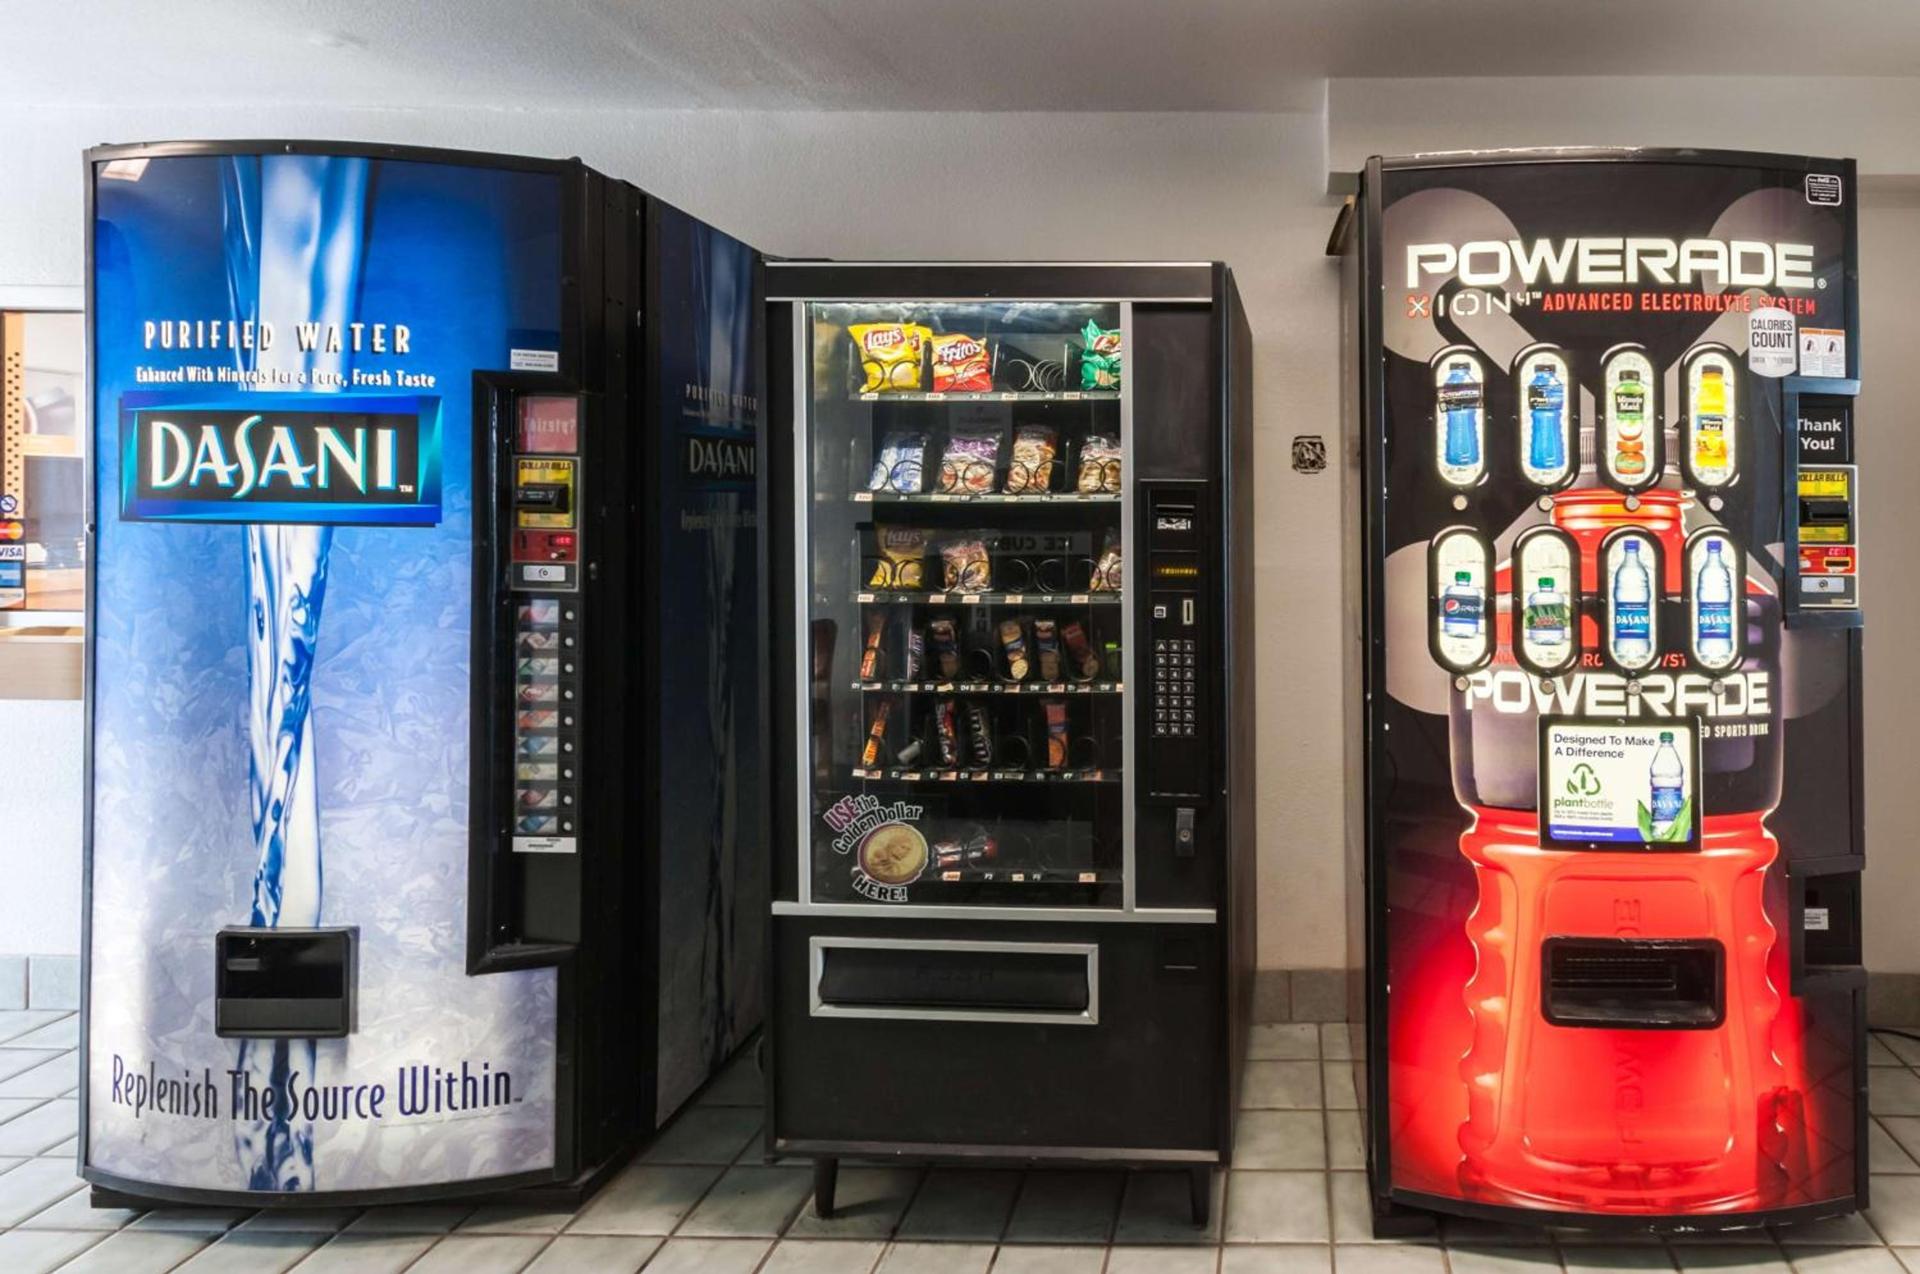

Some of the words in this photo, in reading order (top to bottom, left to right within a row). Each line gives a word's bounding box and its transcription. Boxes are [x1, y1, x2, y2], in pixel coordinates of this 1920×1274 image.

[1542, 292, 1633, 312] ADVANCED
[1641, 292, 1751, 313] ELECTROLYTE
[1759, 296, 1816, 315] SYSTEM
[1751, 318, 1793, 331] CALORIES
[144, 320, 275, 351] PURIFIED
[296, 321, 411, 355] WATER
[1751, 332, 1793, 349] COUNT
[136, 366, 184, 383] Enhanced
[187, 366, 214, 383] With
[217, 366, 267, 384] Minerals
[297, 373, 306, 384] a
[352, 367, 391, 386] Fresh
[396, 369, 436, 388] Taste
[1797, 418, 1842, 432] Thank
[1800, 437, 1835, 450] You!
[690, 438, 754, 477] DASANI
[1714, 725, 1748, 737] SPORTS
[1749, 723, 1769, 736] DRINK
[1554, 733, 1607, 747] Designed
[1609, 735, 1622, 746] To
[1625, 736, 1655, 747] Make
[1554, 747, 1563, 756] A
[1566, 747, 1625, 759] Difference
[1554, 797, 1614, 809] plantbottle
[824, 797, 861, 831] USE
[856, 795, 878, 812] the
[833, 813, 877, 854] Golden
[876, 802, 923, 823] Dollar
[853, 876, 907, 901] HERE!
[111, 1053, 218, 1121] Replenish
[227, 1069, 274, 1121] The
[286, 1070, 385, 1121] Source
